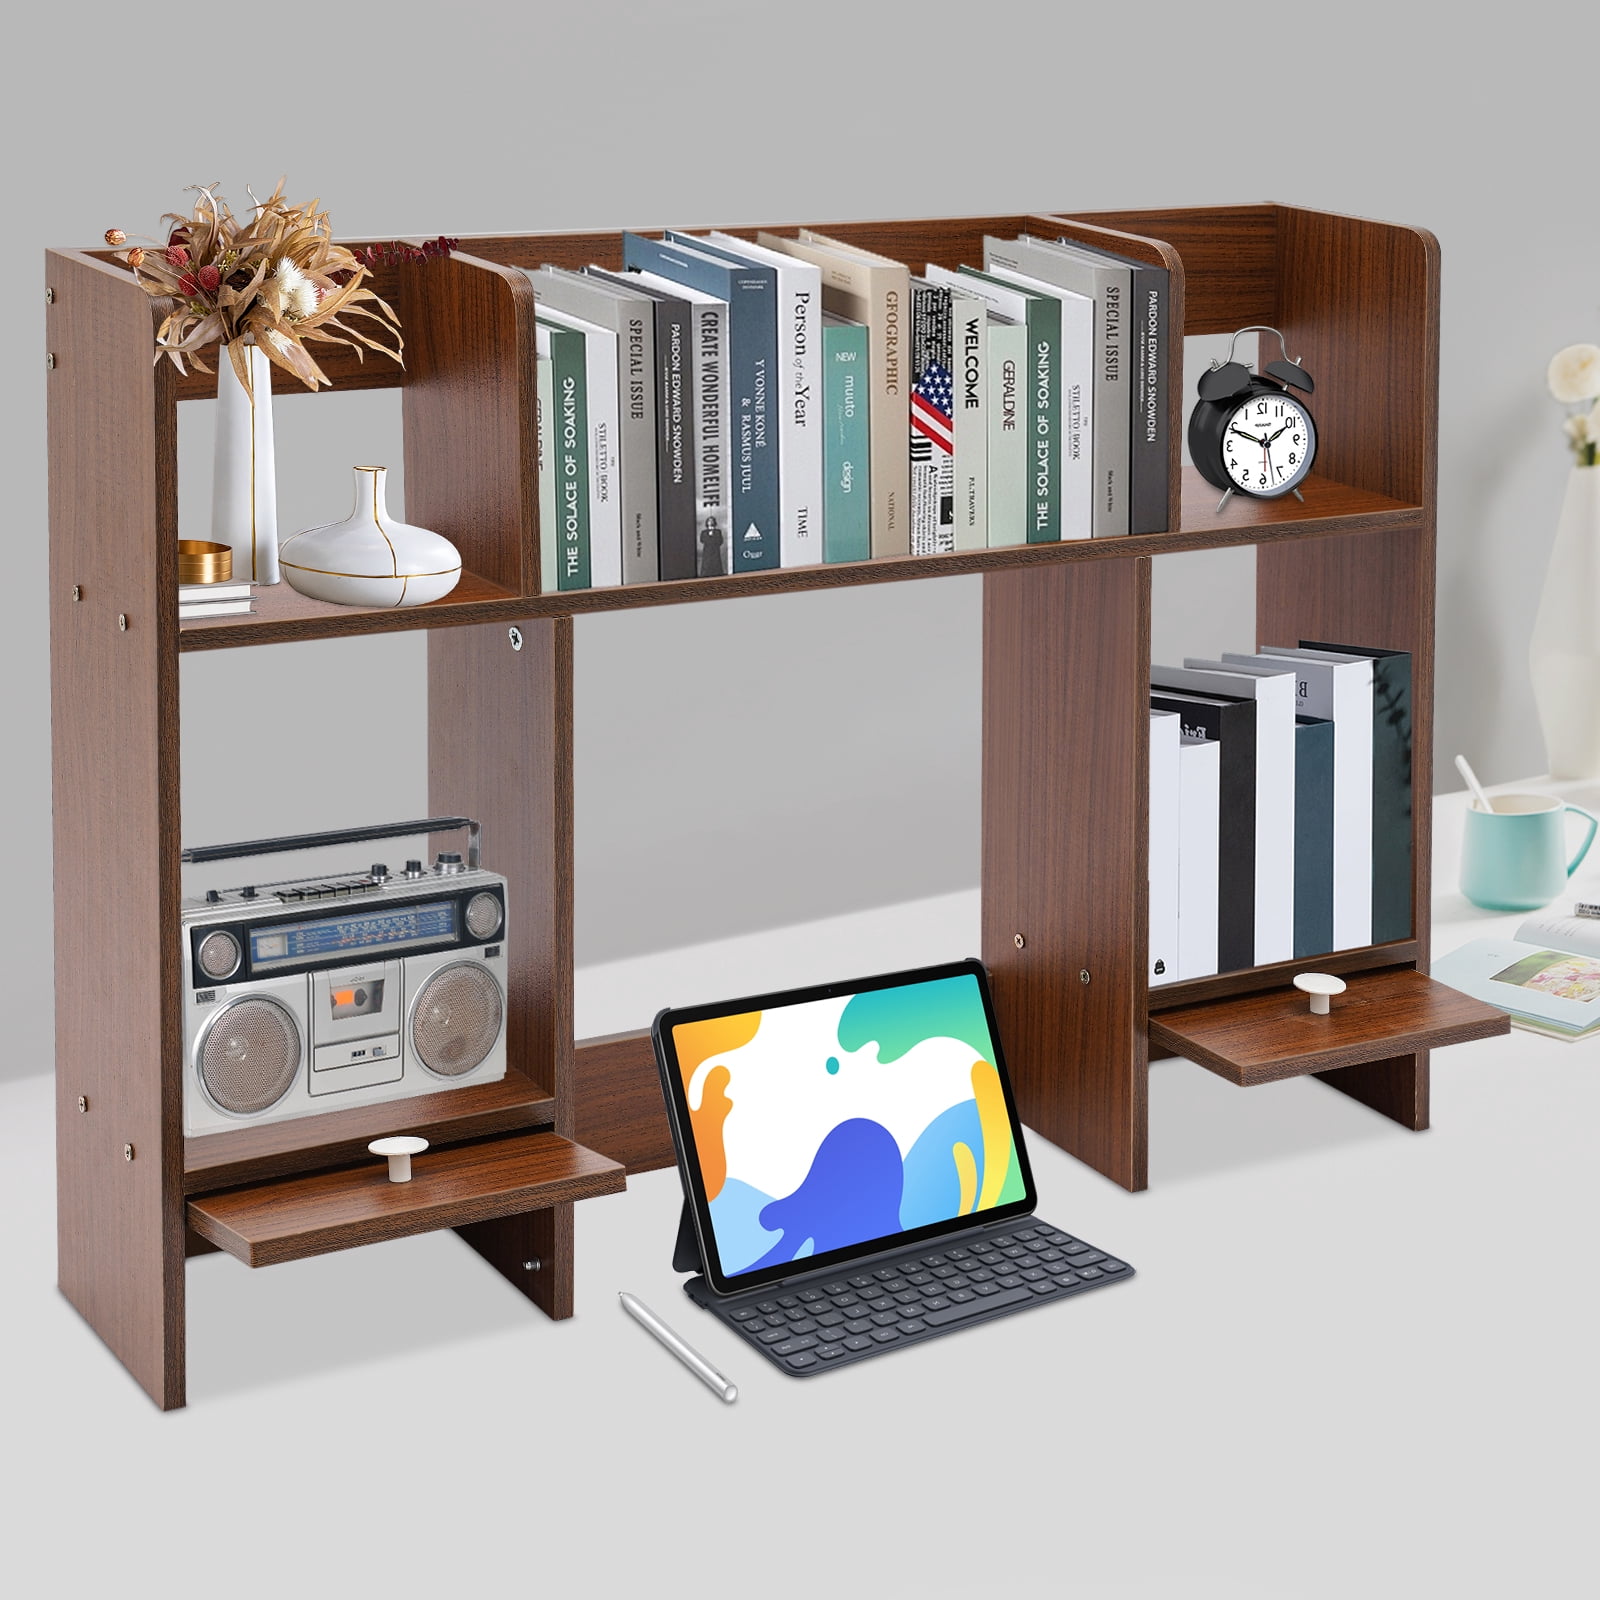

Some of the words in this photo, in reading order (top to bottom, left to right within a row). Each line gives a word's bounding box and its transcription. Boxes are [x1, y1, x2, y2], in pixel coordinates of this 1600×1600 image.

[700, 311, 720, 357] CREATE
[794, 292, 810, 356] Person
[1105, 286, 1120, 341] SPECIAL
[1148, 290, 1158, 336] PARDON
[629, 319, 643, 376] SPECIAL
[671, 323, 681, 371] PARDON
[835, 351, 857, 362] NEW
[886, 290, 899, 396] GEOGRAPHIC
[964, 318, 980, 409] WELCOME
[1105, 344, 1119, 382] ISSUE
[1147, 337, 1158, 385] EDWARD
[671, 373, 682, 423] EDWARD
[754, 359, 765, 413] YVONNE
[844, 375, 856, 418] muuto
[1002, 359, 1016, 432] GERALDINE
[1037, 341, 1050, 409] SOAKING
[562, 376, 577, 449] SOAKING
[630, 380, 644, 420] ISSUE
[701, 360, 720, 441] WONDERFUL
[741, 397, 751, 407] &
[794, 385, 810, 427] Year
[1037, 414, 1049, 435] OF
[1147, 386, 1157, 442] SNOWDEN
[672, 424, 683, 483] SNOWDEN
[741, 414, 752, 463] RASMUS
[564, 454, 577, 476] OF
[702, 444, 720, 508] HOMELIFE
[740, 464, 752, 494] JUUL
[1036, 439, 1049, 497] SOLACE
[565, 481, 578, 541] SOLACE
[797, 506, 809, 538] TIME
[1036, 501, 1049, 531] THE
[566, 546, 579, 577] THE
